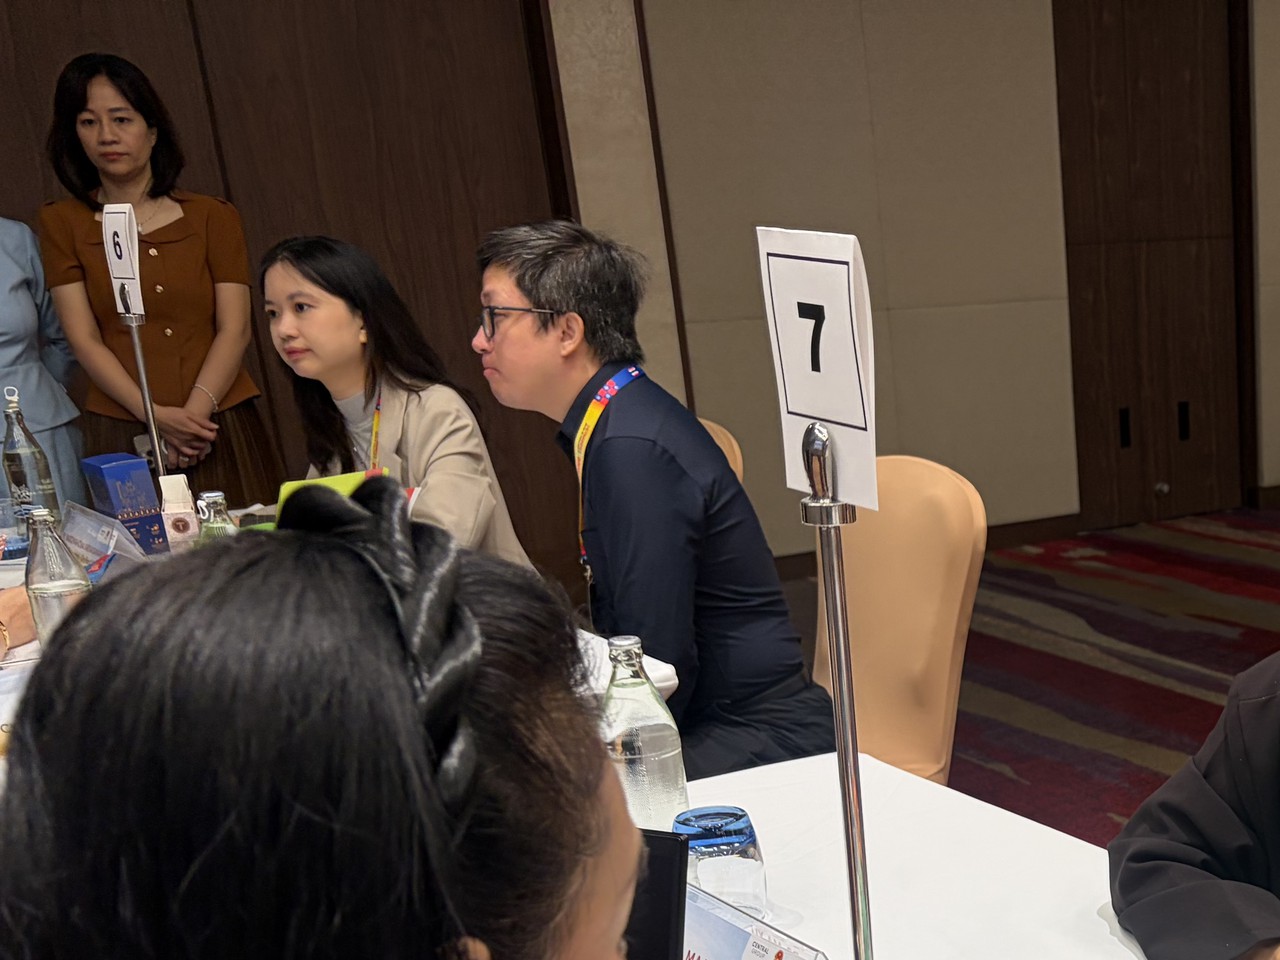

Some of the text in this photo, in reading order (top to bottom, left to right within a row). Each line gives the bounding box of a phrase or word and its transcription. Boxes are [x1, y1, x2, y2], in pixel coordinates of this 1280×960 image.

[112, 230, 123, 260] 6
[796, 301, 826, 373] 7
[752, 941, 769, 954] CENTRAL
